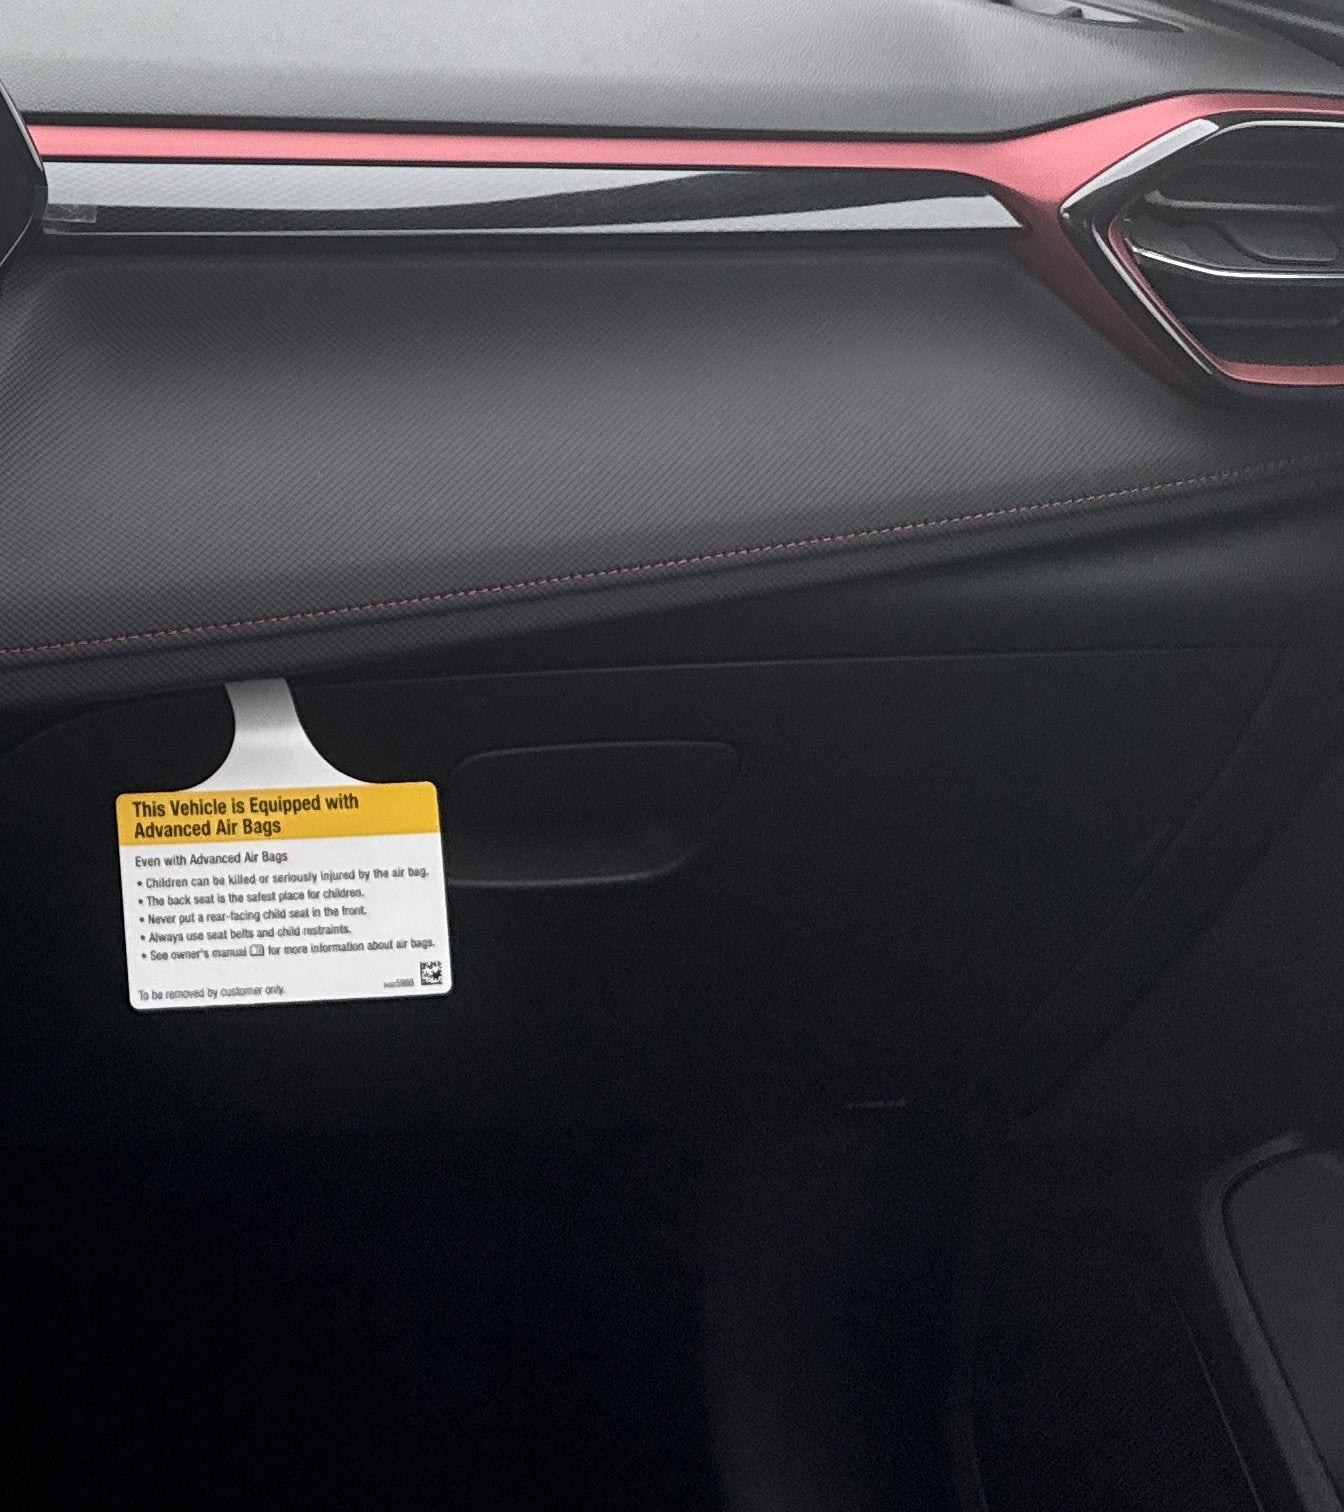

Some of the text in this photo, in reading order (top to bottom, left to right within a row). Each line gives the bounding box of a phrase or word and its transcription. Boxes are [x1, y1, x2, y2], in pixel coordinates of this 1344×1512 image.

[132, 793, 359, 818] This Vehicle is Equipped with
[134, 818, 282, 839] Advanced Air Bags
[135, 850, 289, 868] Even with Advanced Air Bags
[145, 866, 429, 888] Children can be killed or seriously injured by the air bag.
[146, 888, 365, 906] The back seat is the safest place for children.
[148, 913, 176, 925] Never
[179, 912, 196, 925] put
[263, 908, 287, 920] child
[288, 908, 310, 919] seat
[312, 907, 321, 918] in
[323, 906, 340, 917] the
[148, 931, 184, 944] Always
[186, 931, 204, 941] use
[206, 930, 228, 940] seat
[256, 927, 275, 938] and
[277, 926, 301, 937] child
[150, 949, 169, 961] See
[310, 941, 365, 954] information
[367, 939, 394, 951] about
[396, 938, 408, 949] air
[138, 989, 150, 1001] To
[151, 990, 163, 1000] be
[166, 988, 205, 999] removed
[207, 987, 219, 999] by
[220, 986, 263, 997] customer
